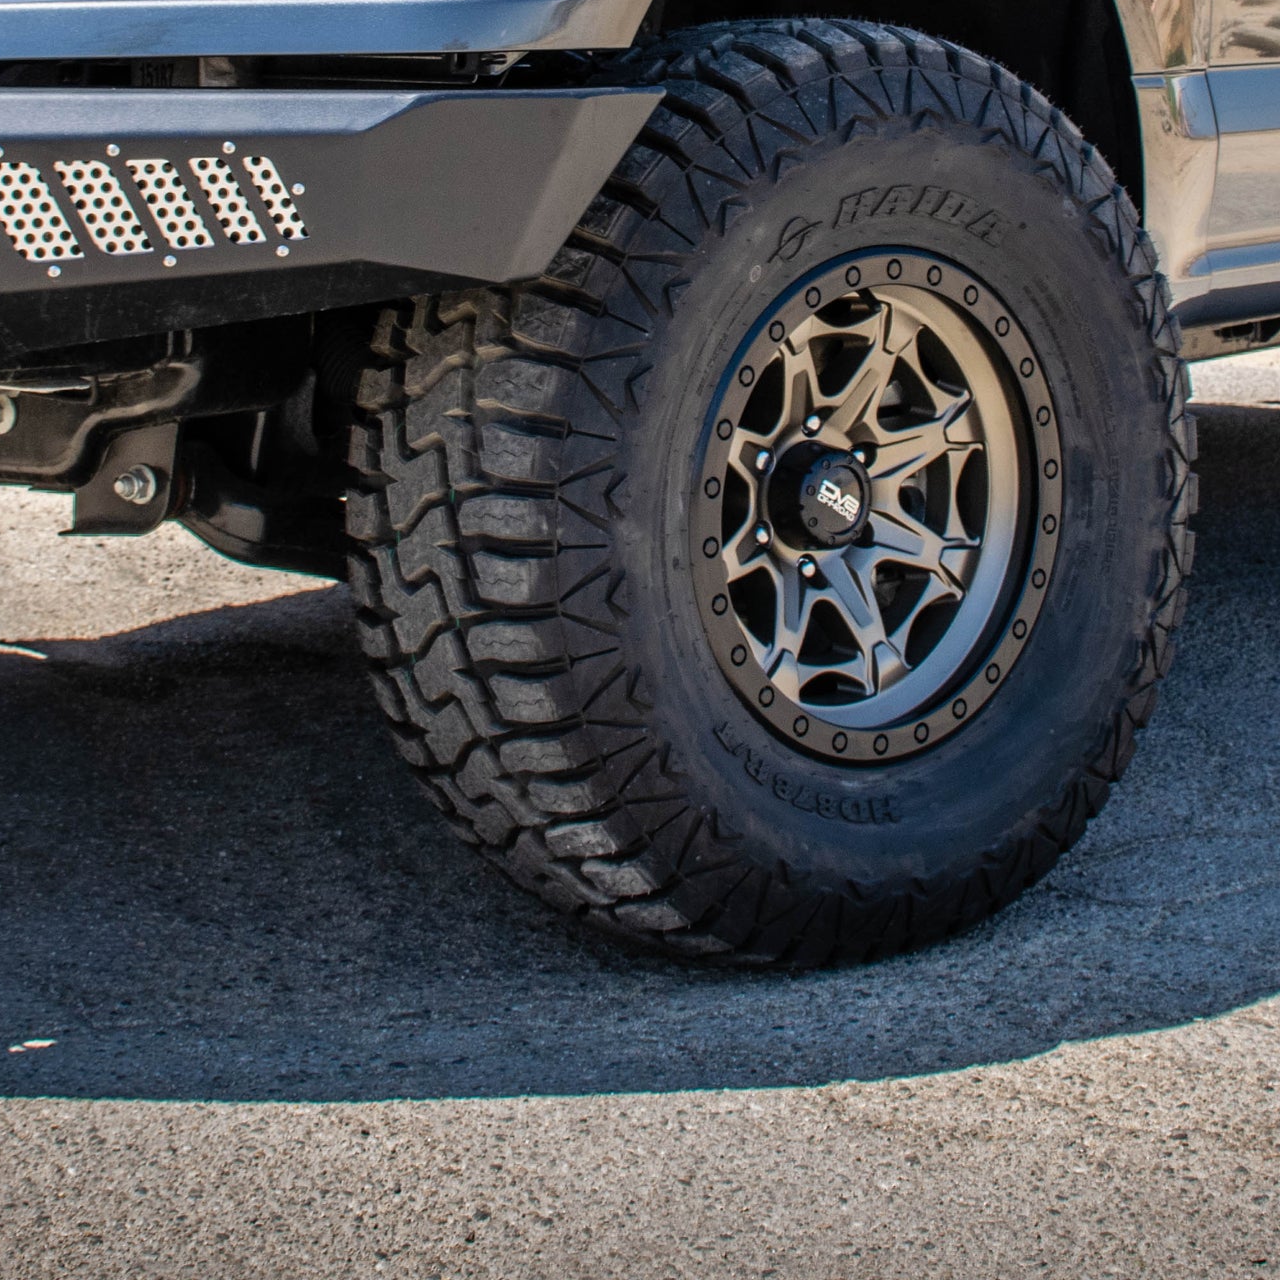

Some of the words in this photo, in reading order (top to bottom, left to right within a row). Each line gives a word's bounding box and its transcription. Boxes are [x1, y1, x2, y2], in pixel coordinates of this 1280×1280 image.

[832, 184, 1010, 247] HAIDA
[820, 480, 860, 514] DV8
[771, 772, 901, 826] HD878
